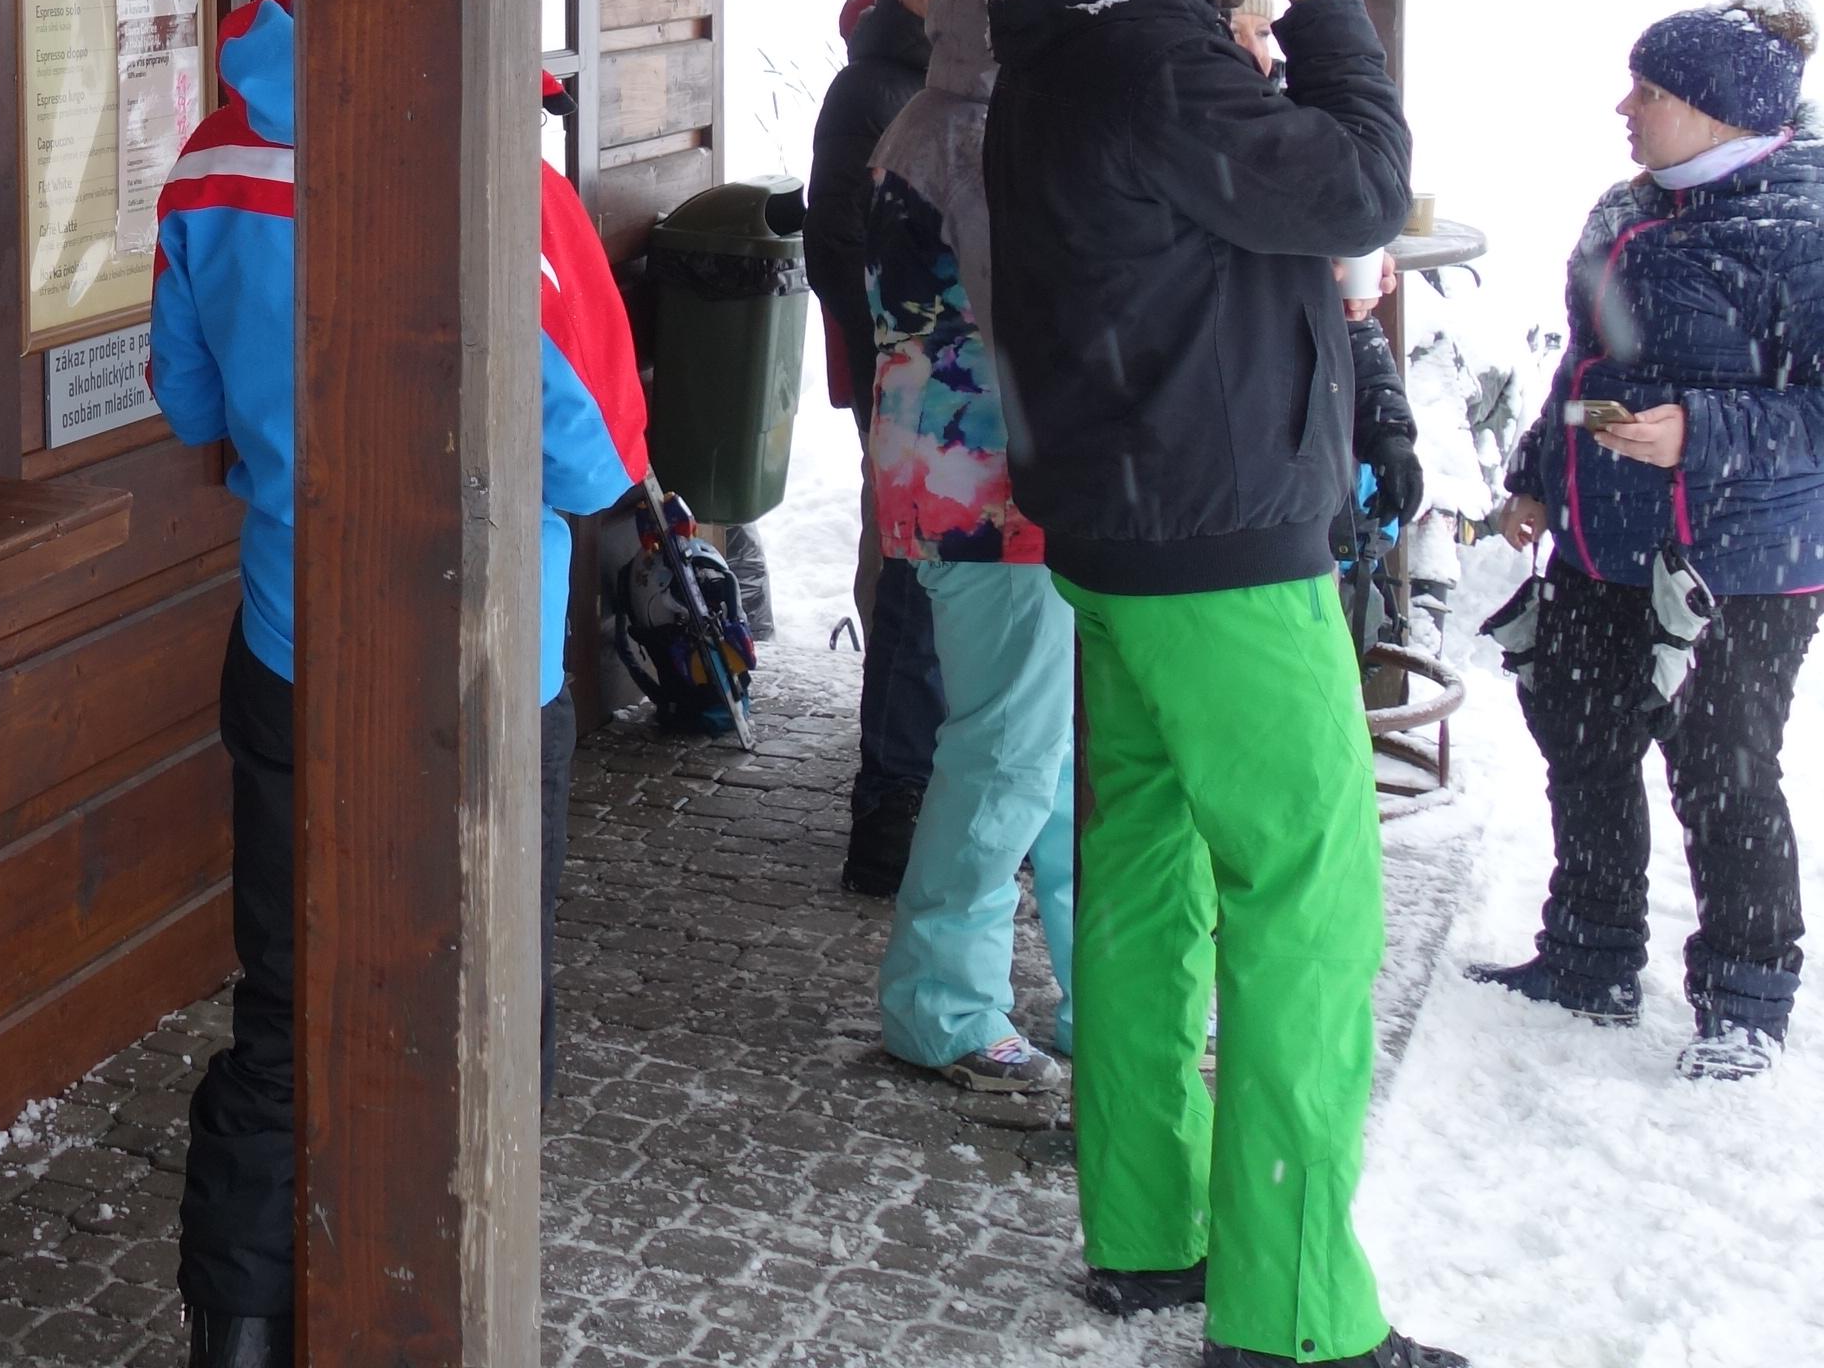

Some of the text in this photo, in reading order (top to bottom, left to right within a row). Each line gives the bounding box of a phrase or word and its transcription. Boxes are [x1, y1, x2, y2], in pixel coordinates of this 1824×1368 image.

[55, 336, 134, 372] zákaz prodeje a
[69, 362, 134, 397] alkoholických
[62, 388, 145, 428] osobám mladším
